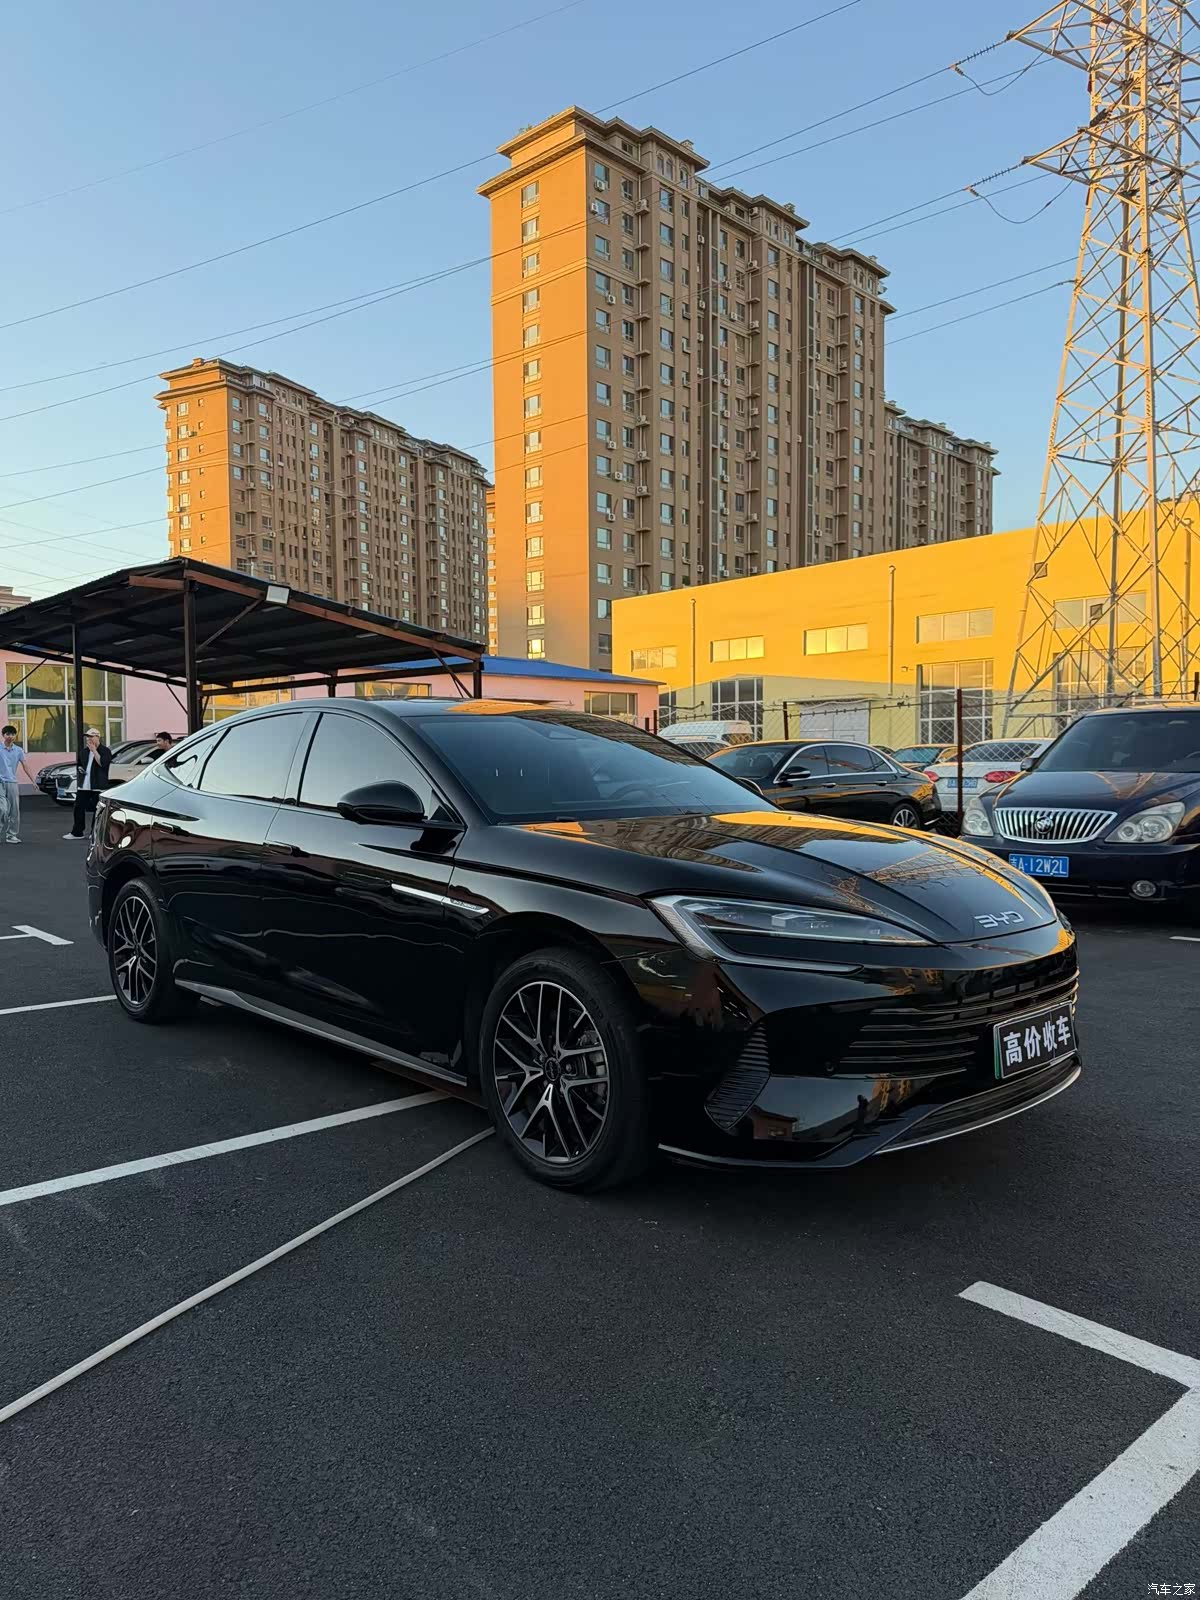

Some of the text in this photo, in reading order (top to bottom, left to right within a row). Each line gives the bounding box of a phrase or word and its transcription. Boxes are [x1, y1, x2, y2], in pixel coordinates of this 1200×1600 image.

[974, 911, 1024, 928] BYD
[1003, 1015, 1071, 1067] 高价收车
